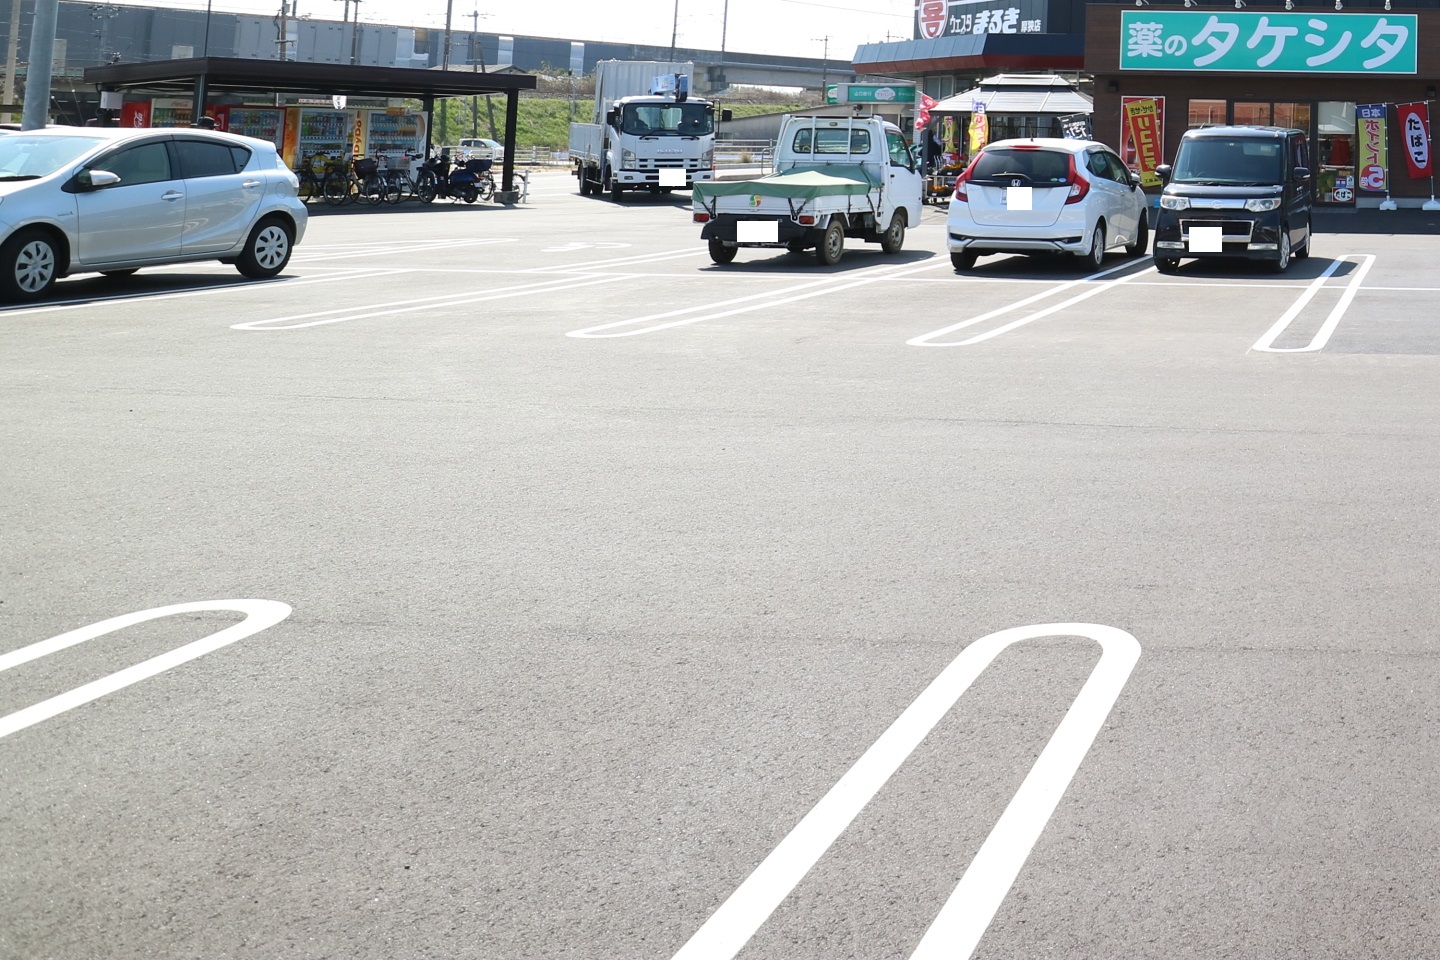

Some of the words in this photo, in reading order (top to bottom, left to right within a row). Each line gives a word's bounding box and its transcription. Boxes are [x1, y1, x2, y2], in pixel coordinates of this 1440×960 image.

[973, 7, 1020, 35] まるき
[1127, 15, 1409, 70] 薬のタケシタ
[1407, 117, 1426, 164] たばこ
